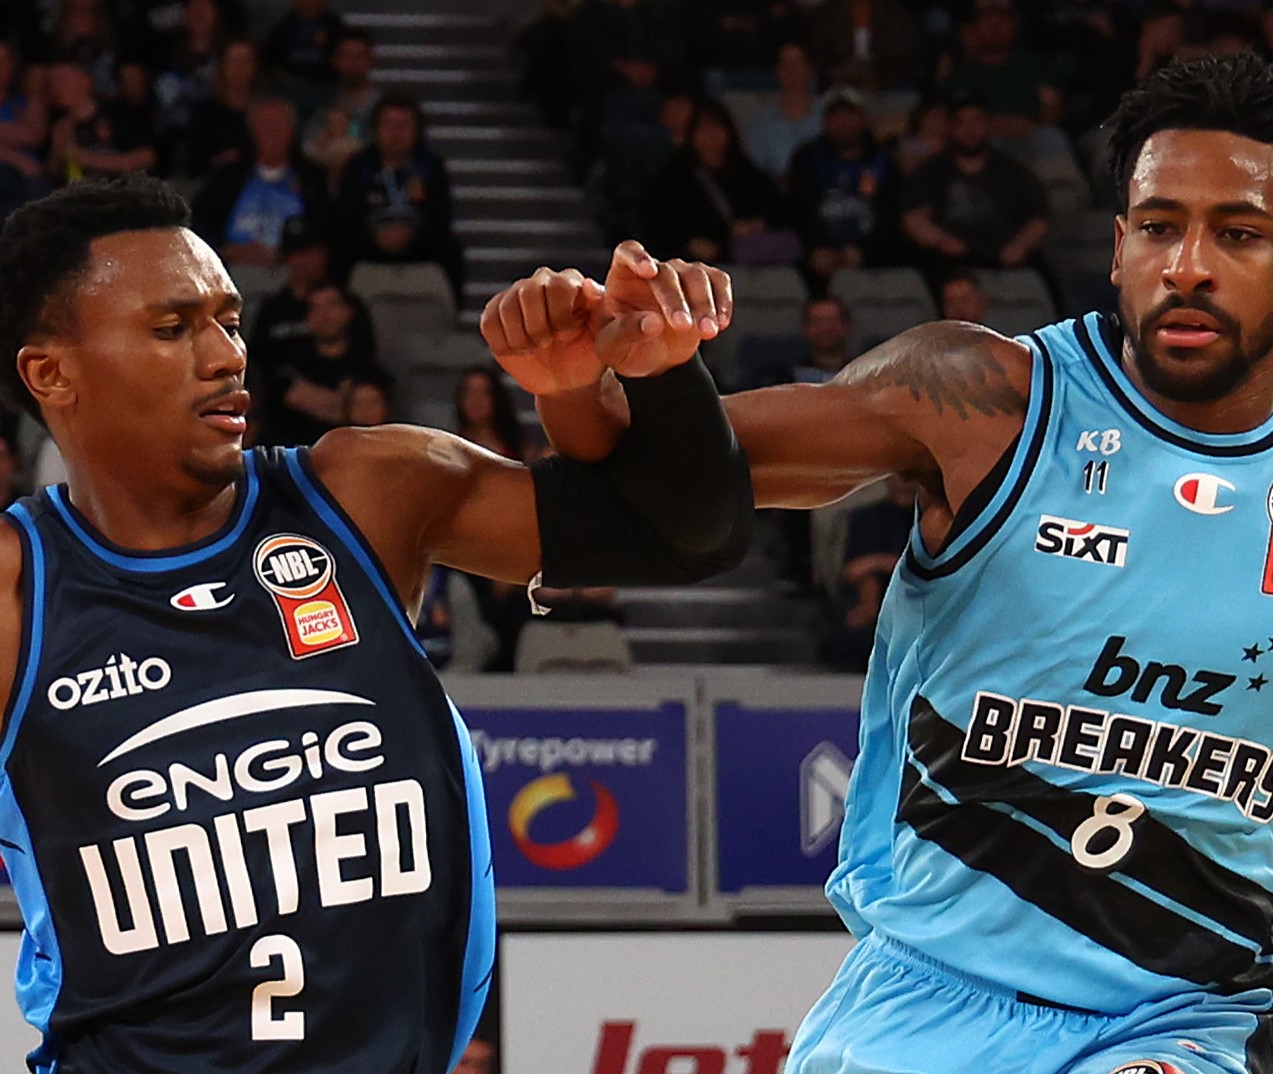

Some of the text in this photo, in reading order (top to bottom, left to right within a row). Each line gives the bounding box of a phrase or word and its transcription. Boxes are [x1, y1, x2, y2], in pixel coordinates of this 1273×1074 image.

[1077, 429, 1121, 455] KB
[1082, 459, 1109, 496] 11
[269, 548, 319, 583] NBL
[298, 609, 334, 624] HUNGRY
[47, 653, 172, 709] ozito
[1082, 635, 1237, 716] bnz
[1070, 793, 1146, 869] 8
[78, 778, 432, 956] UNITED
[249, 933, 305, 1041] 2
